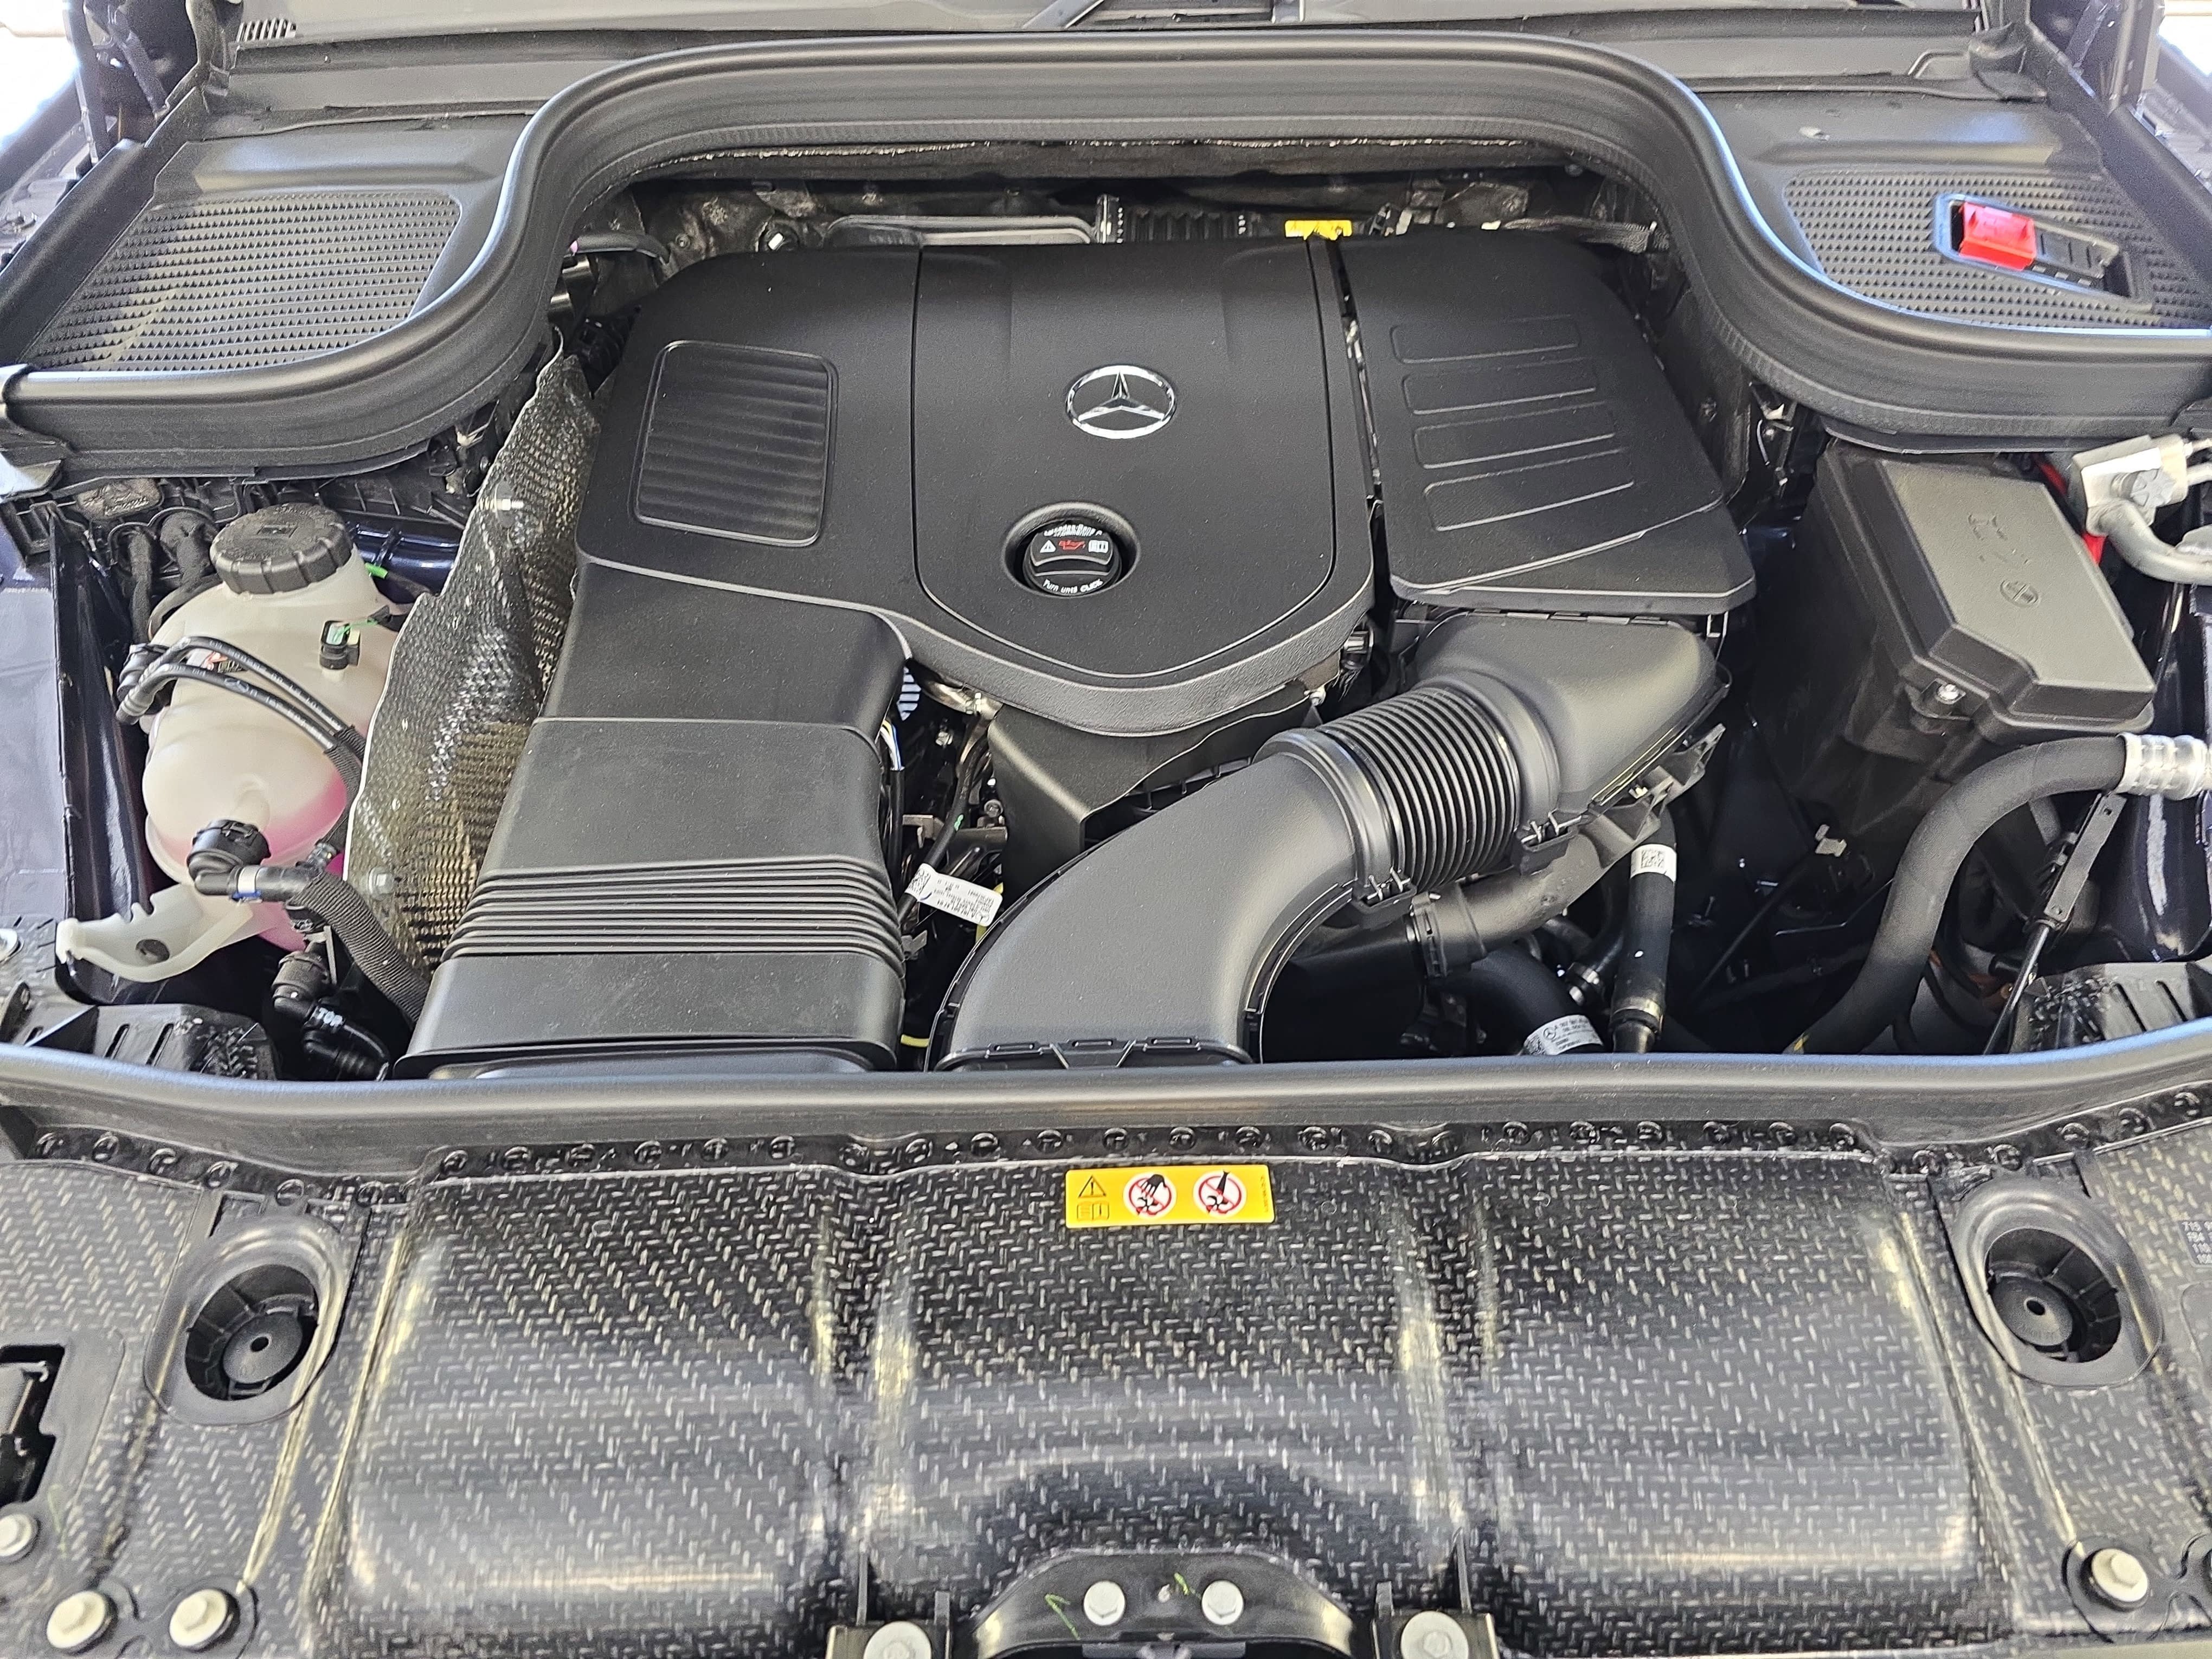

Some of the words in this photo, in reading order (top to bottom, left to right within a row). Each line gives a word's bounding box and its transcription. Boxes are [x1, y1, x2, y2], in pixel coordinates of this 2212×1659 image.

[1043, 578, 1059, 591] Turn
[1060, 586, 1078, 594] until
[317, 1007, 343, 1026] TOP
